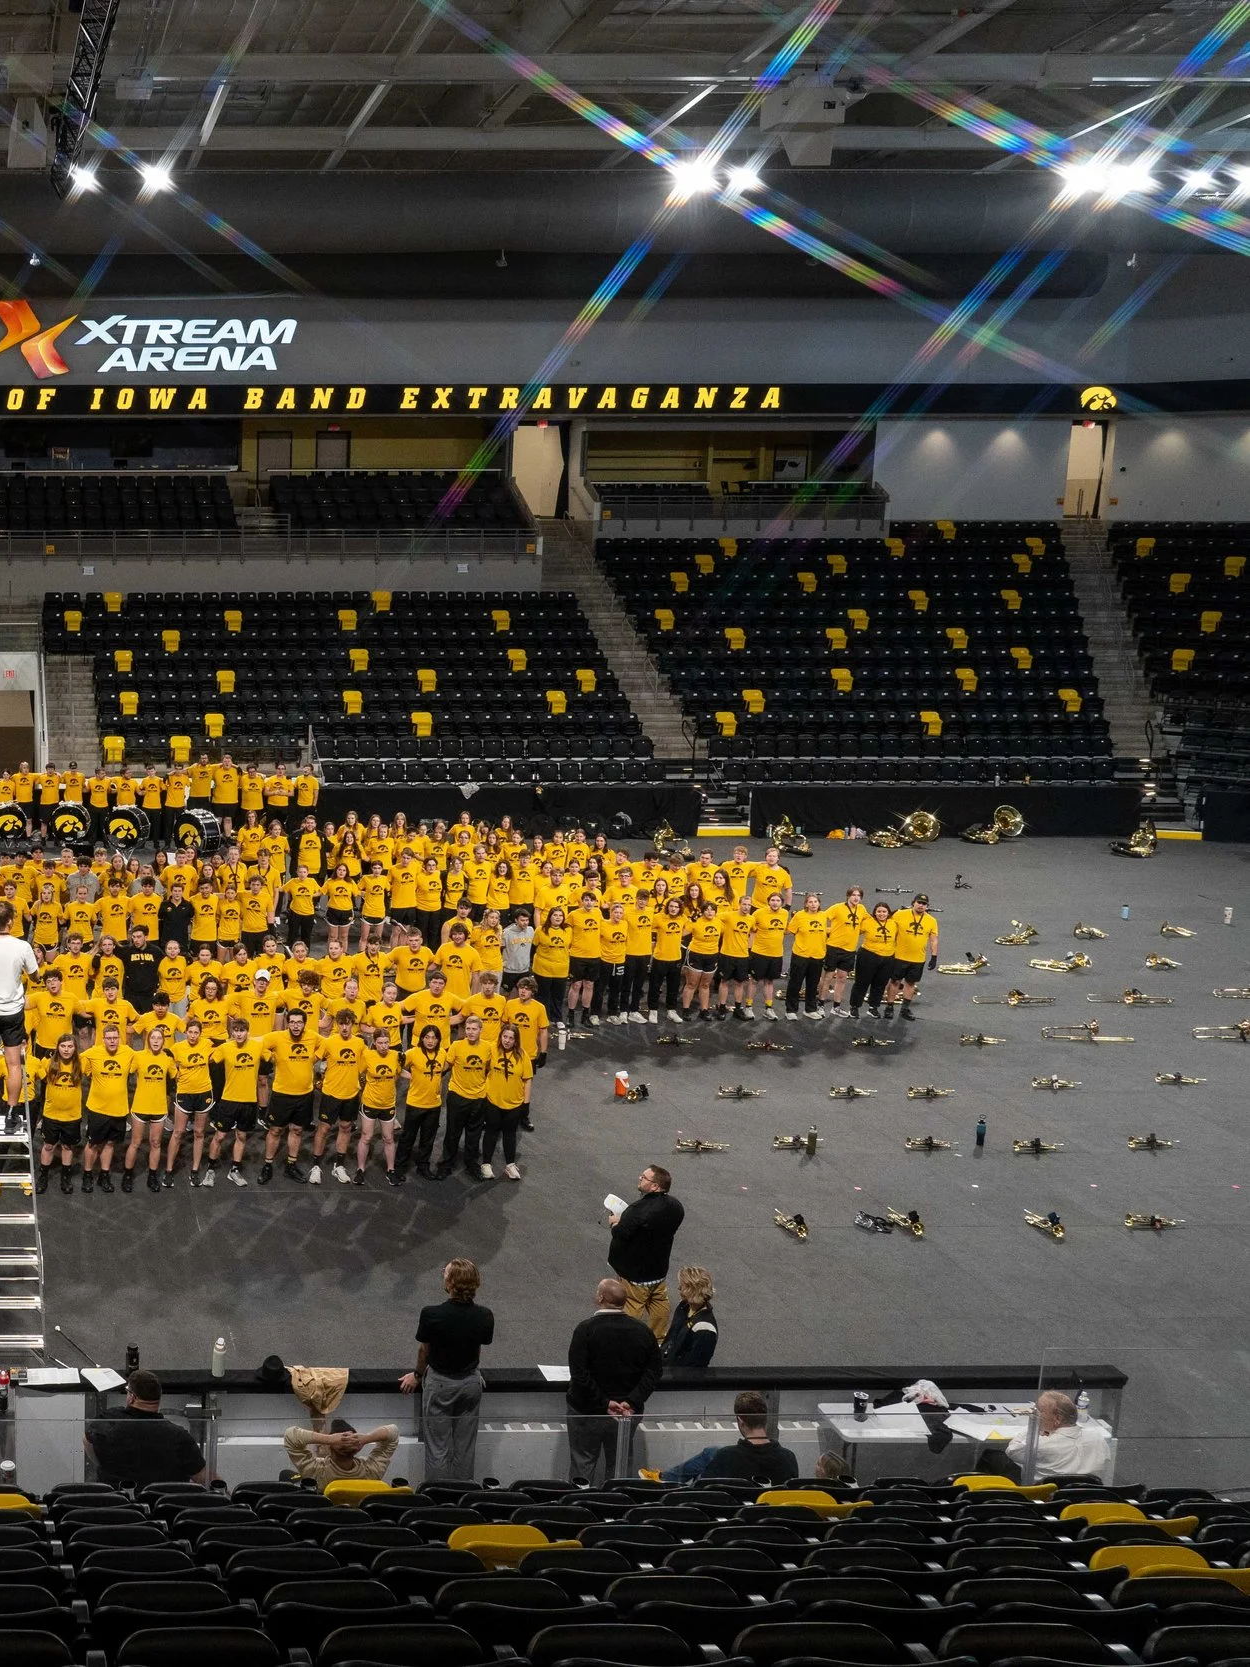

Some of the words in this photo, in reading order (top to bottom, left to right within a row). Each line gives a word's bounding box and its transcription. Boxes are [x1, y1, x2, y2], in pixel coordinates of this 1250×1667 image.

[74, 314, 297, 345] XTREAM
[97, 346, 278, 373] ARENA
[6, 388, 57, 411] OF
[90, 387, 207, 410] IOWA
[244, 387, 367, 410] BAND
[401, 387, 780, 409] EXTRAVAGANZA
